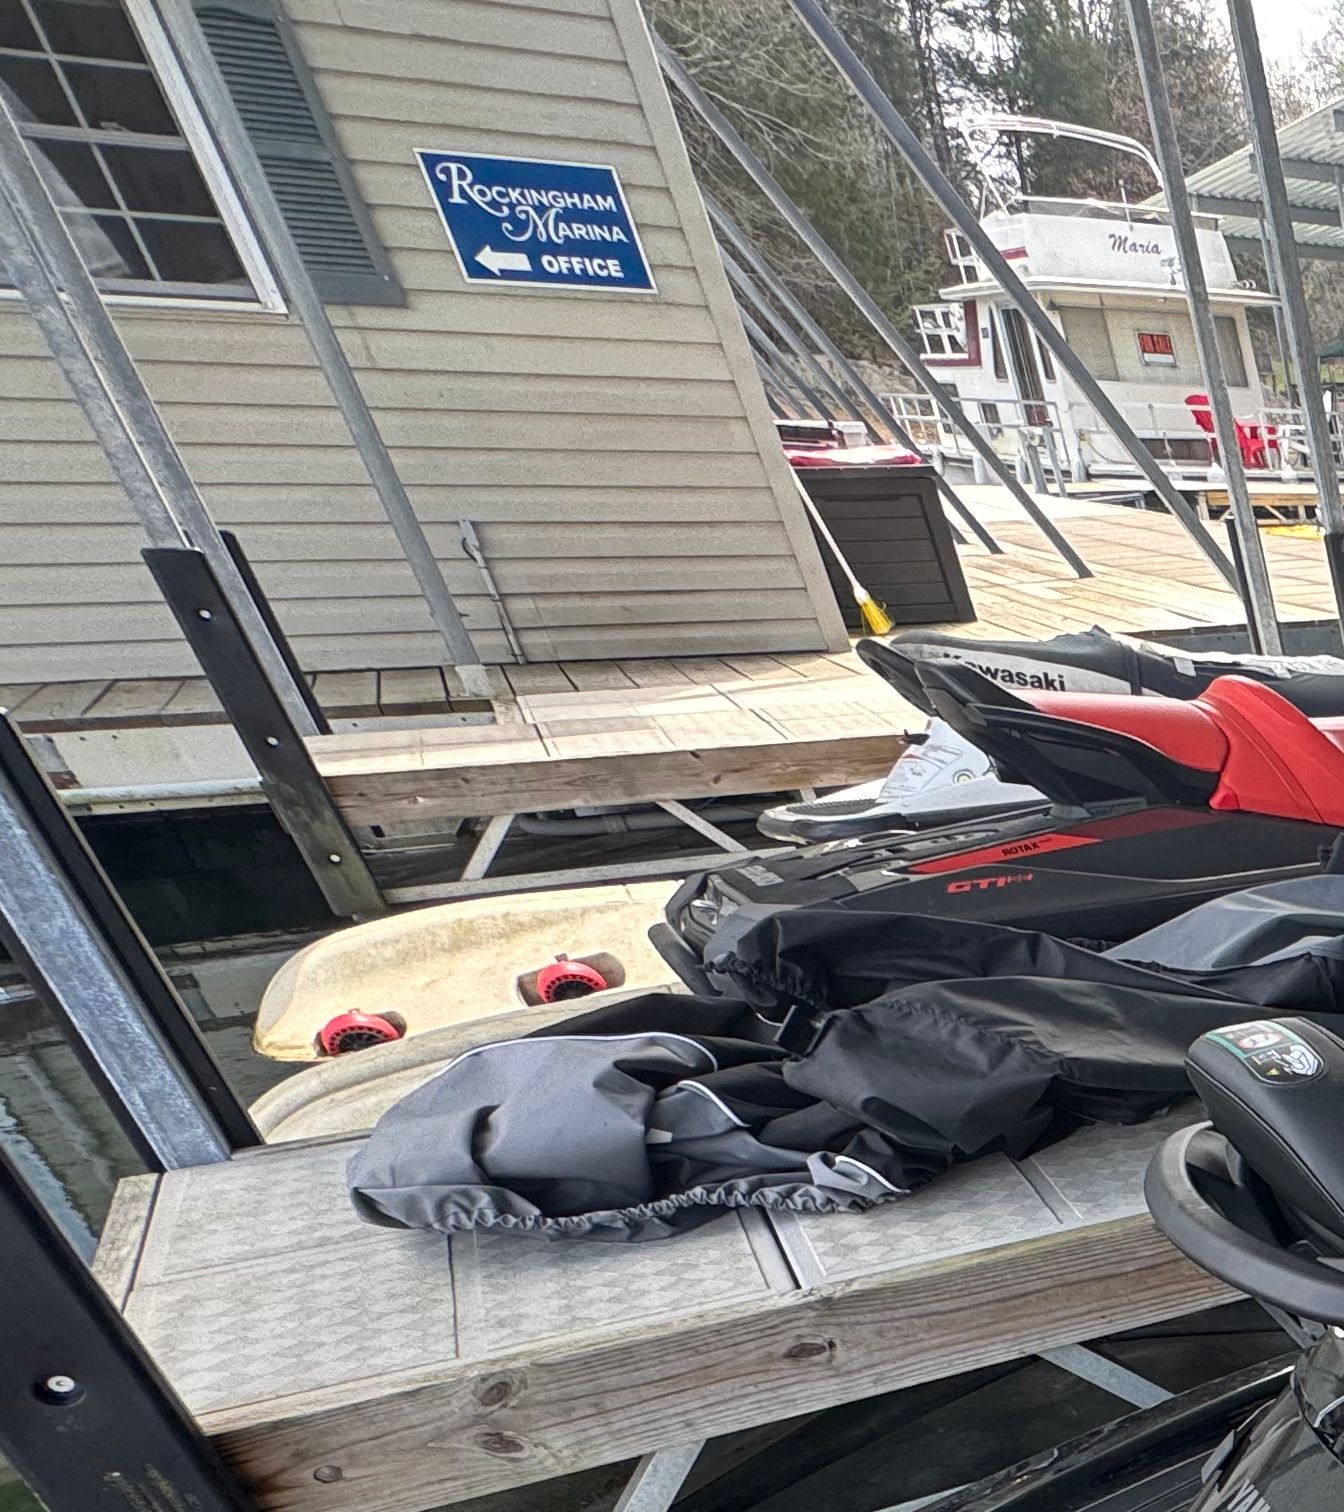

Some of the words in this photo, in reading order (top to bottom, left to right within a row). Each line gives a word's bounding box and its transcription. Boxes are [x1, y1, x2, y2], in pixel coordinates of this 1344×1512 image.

[435, 161, 617, 218] ROCKINGHAM
[502, 205, 629, 245] MARINA
[1108, 233, 1162, 255] Maria
[541, 254, 625, 278] OFFICE
[943, 652, 1066, 692] wasaki
